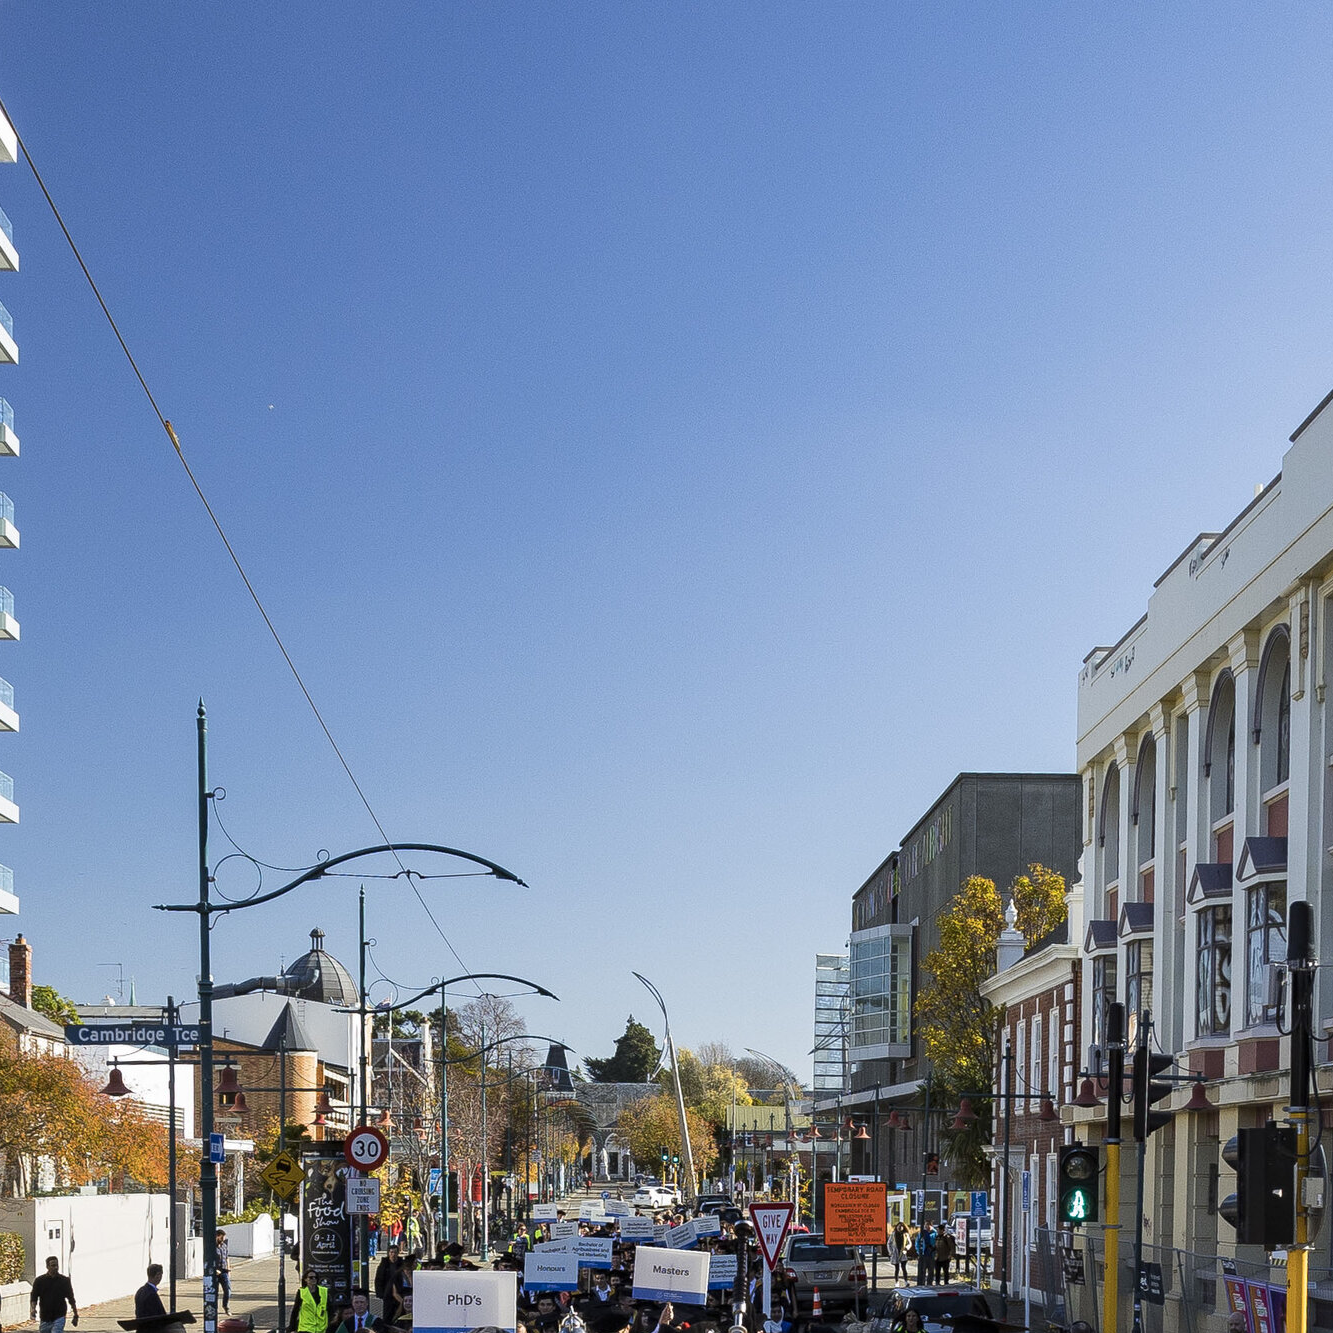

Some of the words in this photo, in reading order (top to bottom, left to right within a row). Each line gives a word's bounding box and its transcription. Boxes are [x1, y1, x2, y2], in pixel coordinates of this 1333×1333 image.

[78, 1028, 165, 1044] Cambridge
[172, 1027, 199, 1041] Tce
[354, 1140, 379, 1157] 30
[314, 1192, 334, 1206] The
[313, 1217, 340, 1229] Show
[762, 1214, 781, 1229] GIVE
[766, 1233, 778, 1244] WAY
[316, 1241, 336, 1249] April
[537, 1264, 566, 1272] Honours
[652, 1265, 690, 1277] Masters
[447, 1293, 483, 1306] PhD's
